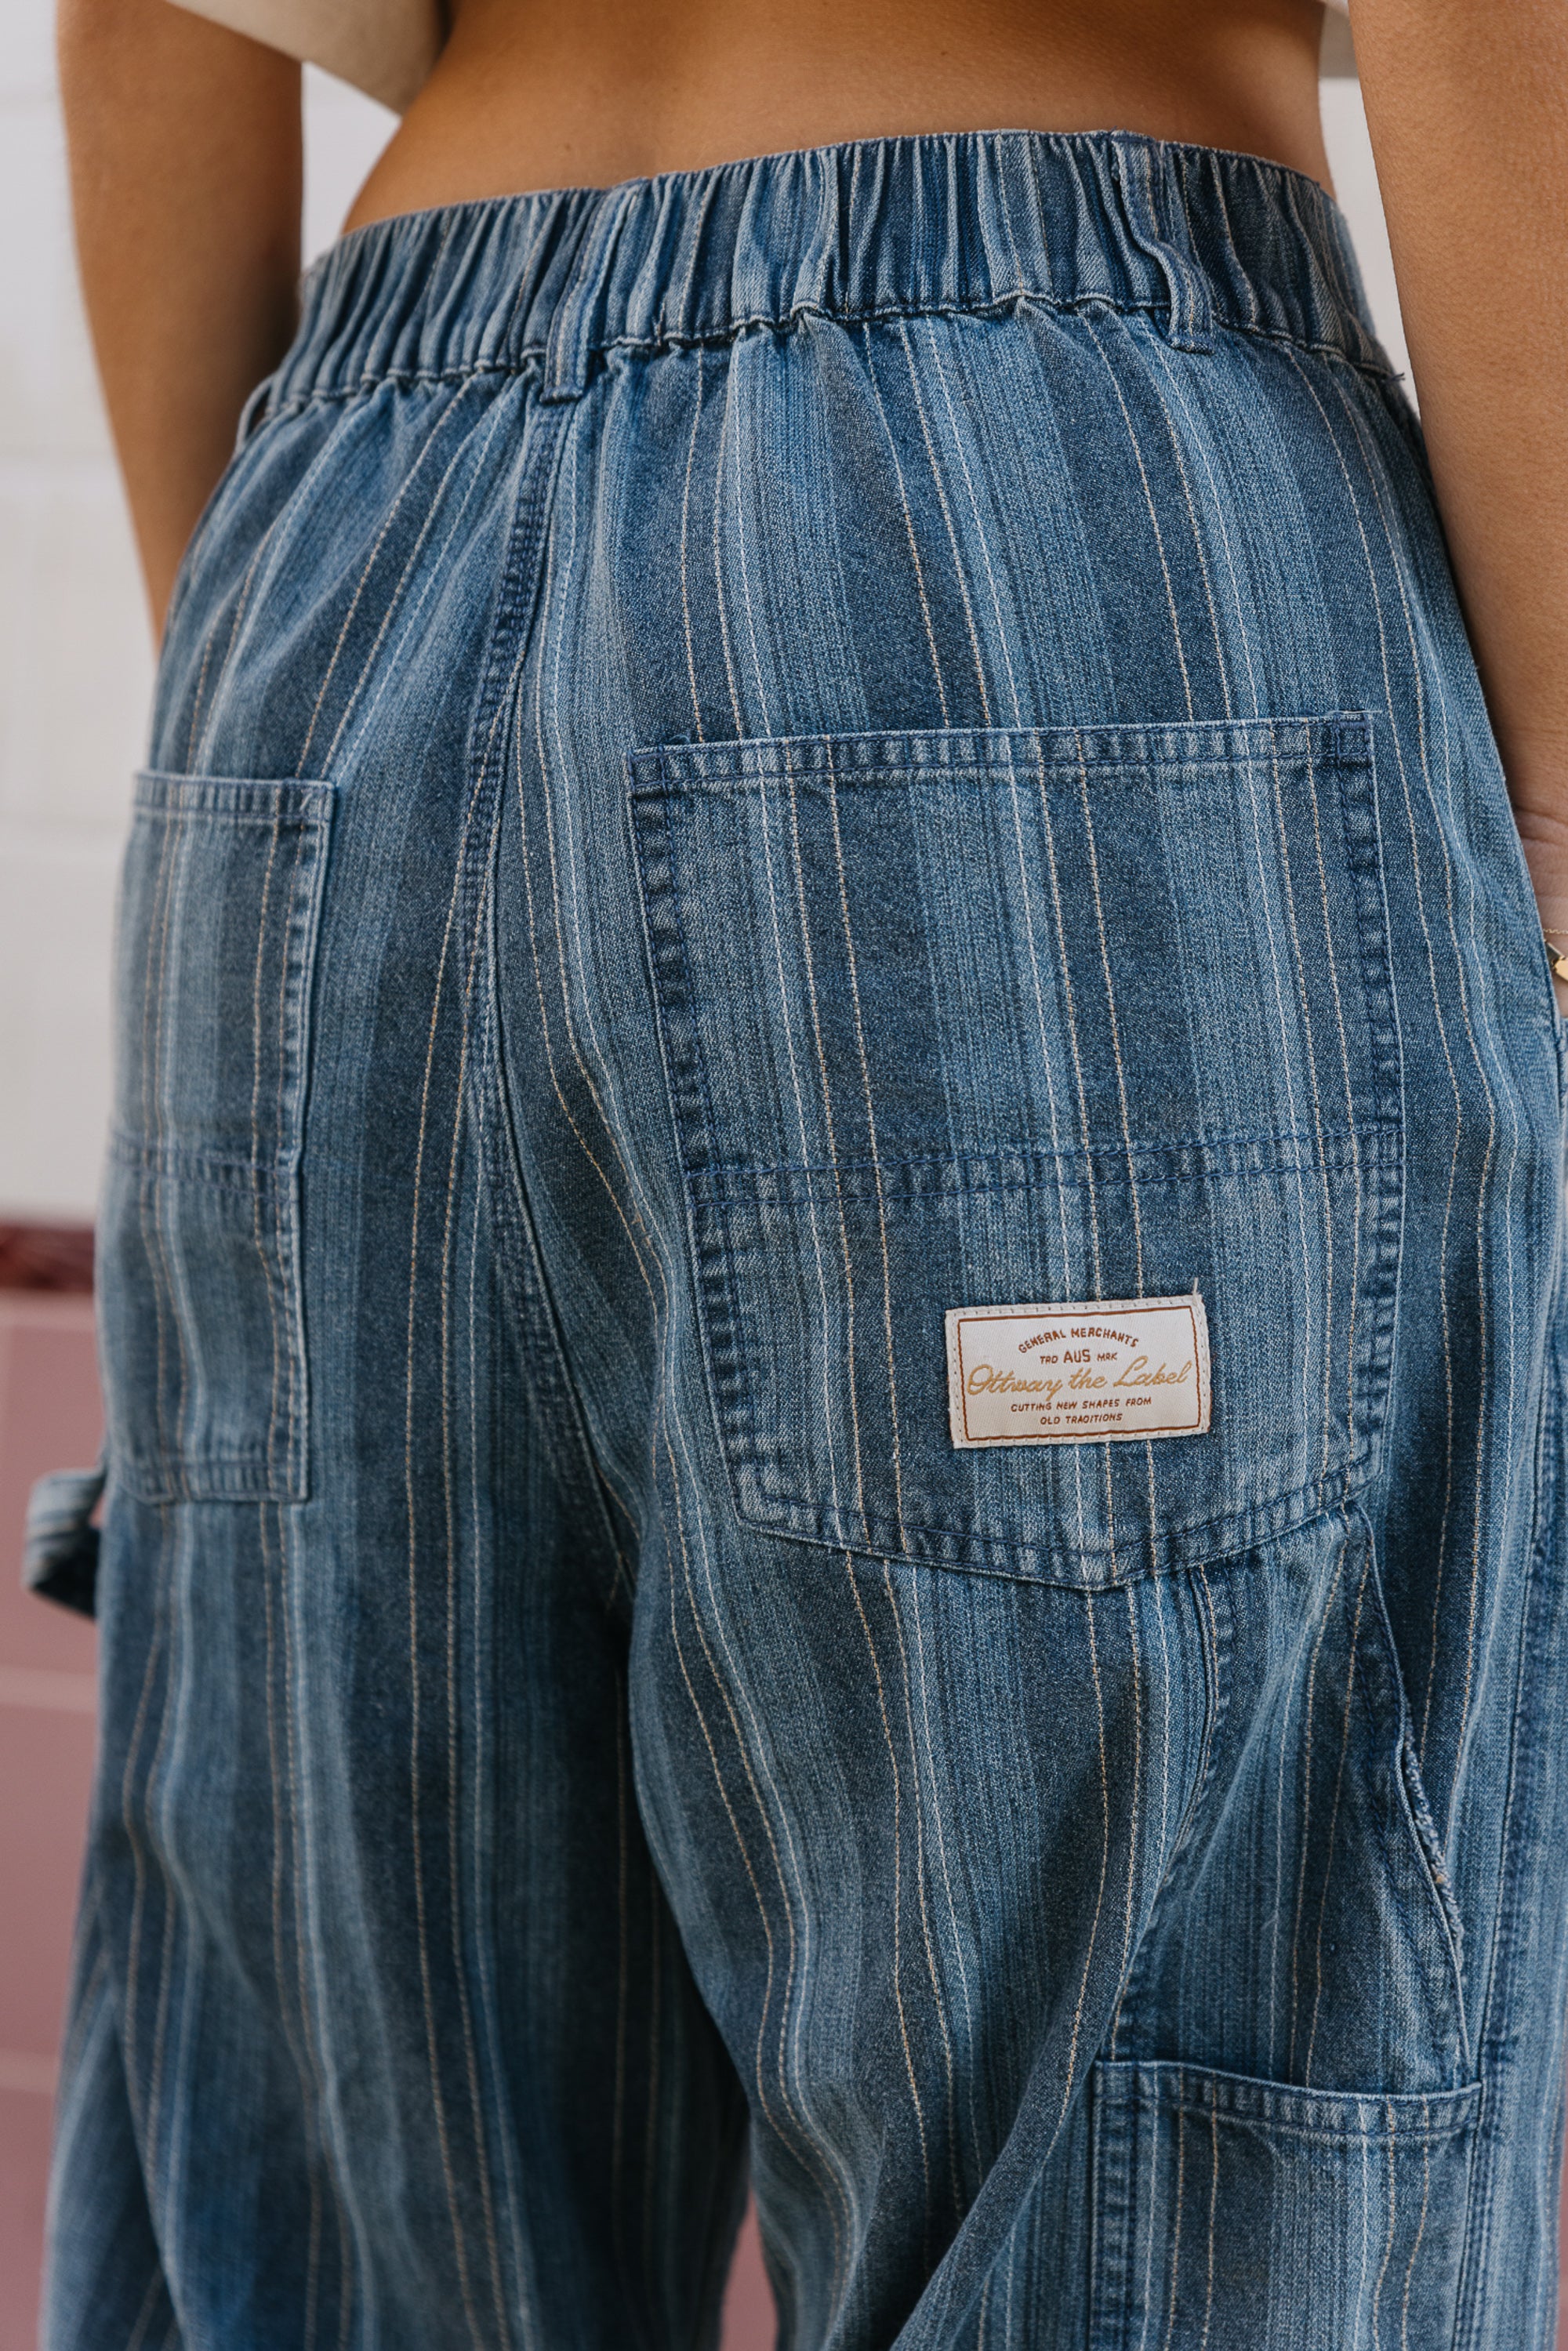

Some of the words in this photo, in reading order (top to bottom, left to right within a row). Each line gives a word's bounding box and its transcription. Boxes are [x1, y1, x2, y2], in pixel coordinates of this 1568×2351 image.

[1018, 1329, 1066, 1353] GENERAL
[1071, 1327, 1139, 1348] MERCHANTS
[1040, 1355, 1058, 1365] TRD
[1063, 1349, 1091, 1363] AUS
[1097, 1351, 1118, 1362] MRK
[967, 1363, 1063, 1401] Ottway
[1069, 1366, 1108, 1389] the
[1113, 1355, 1192, 1388] Label
[1011, 1402, 1052, 1413] CUTTING
[1056, 1401, 1078, 1410] NEW
[1082, 1399, 1120, 1410] SHAPES
[1125, 1396, 1152, 1406] FROM
[1040, 1415, 1060, 1425] OLD
[1065, 1413, 1123, 1424] TRADITIONS
